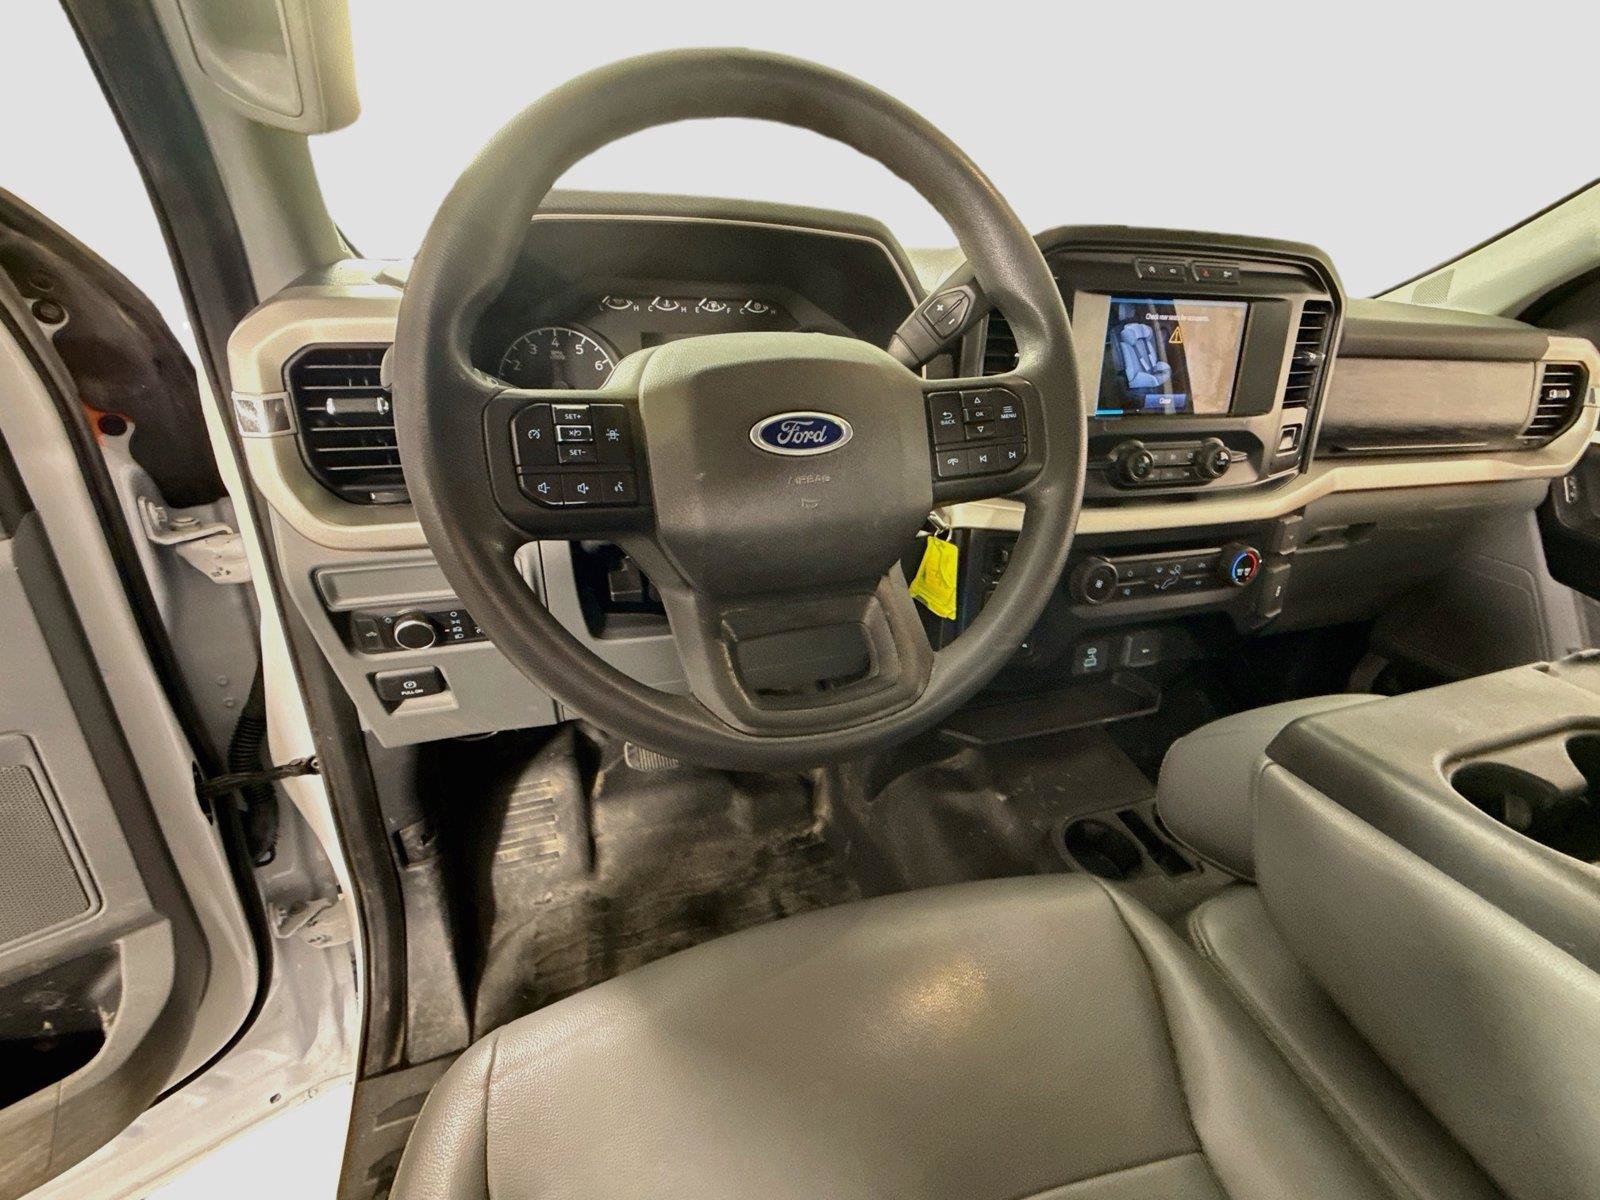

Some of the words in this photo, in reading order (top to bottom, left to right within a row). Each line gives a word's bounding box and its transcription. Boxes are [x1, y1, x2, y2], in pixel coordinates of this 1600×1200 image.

[551, 337, 560, 348] 4
[529, 343, 538, 355] 3
[575, 343, 584, 355] 5
[594, 360, 604, 371] 6
[777, 420, 828, 445] Ford
